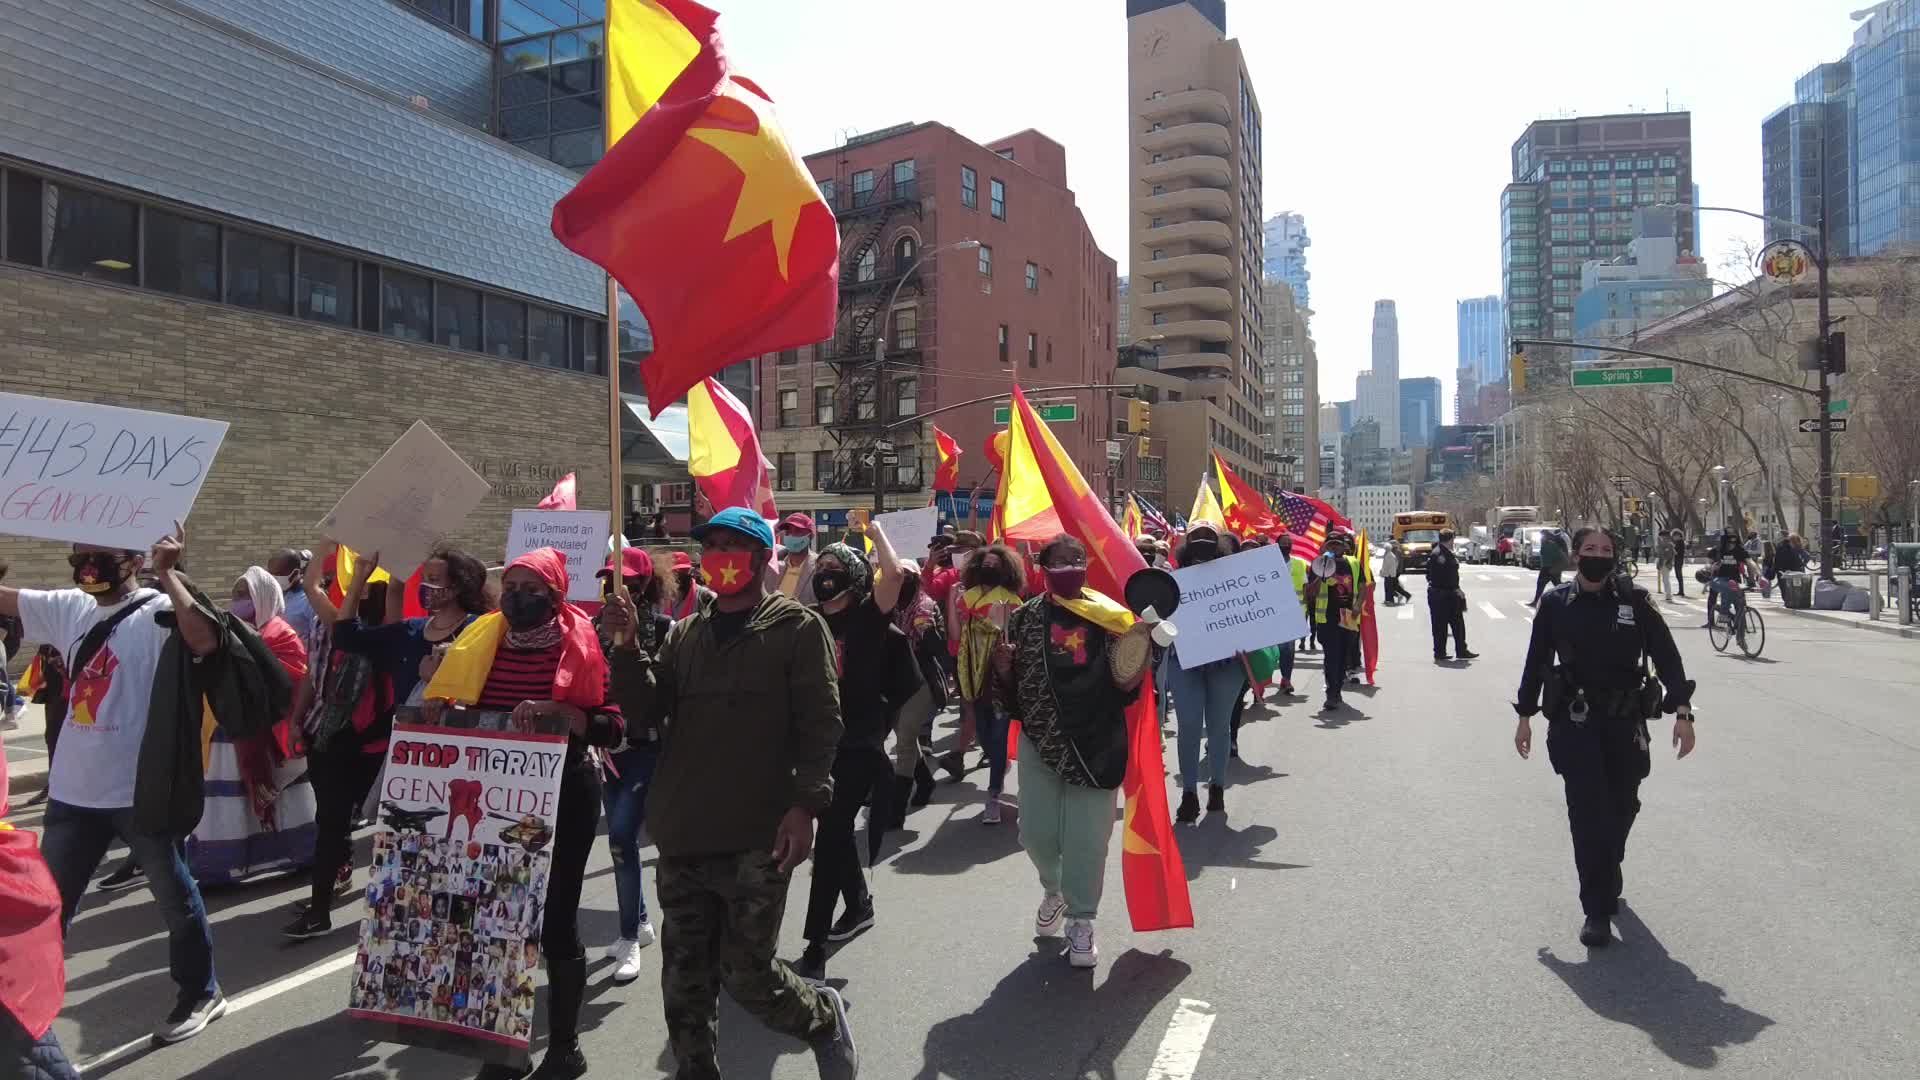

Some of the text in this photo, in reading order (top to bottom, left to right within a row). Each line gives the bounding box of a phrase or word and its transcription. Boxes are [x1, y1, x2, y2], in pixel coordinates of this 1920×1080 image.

[1602, 370, 1643, 382] Spring St
[97, 429, 207, 487] DAYS
[1, 482, 161, 529] GENOCIDE
[523, 521, 594, 535] We Demand an
[524, 537, 539, 548] UN
[1179, 569, 1281, 605] EthioHRC is a
[1209, 590, 1261, 614] corrupt
[1205, 605, 1276, 633] institution
[391, 740, 562, 778] STOP TIGRAY
